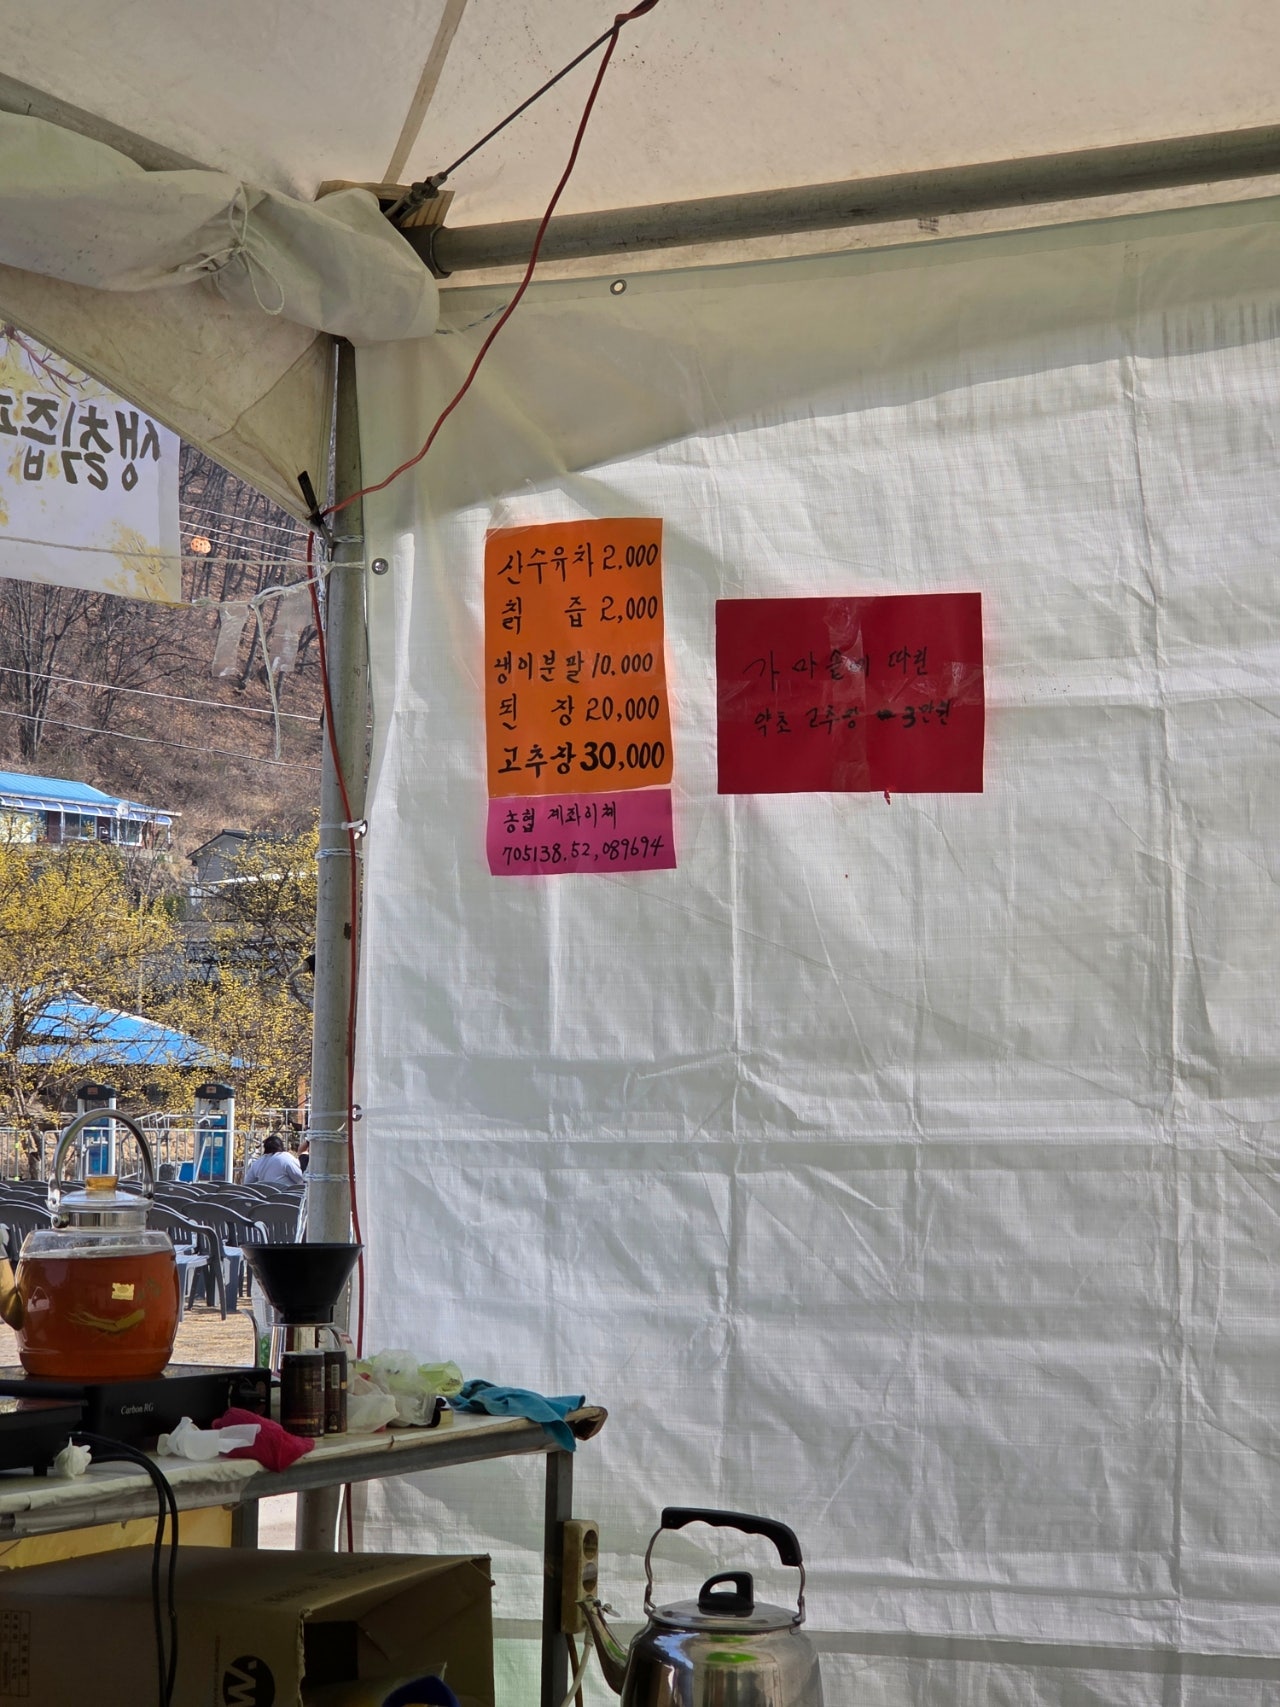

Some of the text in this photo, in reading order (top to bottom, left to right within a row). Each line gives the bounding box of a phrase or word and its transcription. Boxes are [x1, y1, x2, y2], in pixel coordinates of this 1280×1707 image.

[497, 542, 594, 585] 산수유차
[600, 595, 658, 624] 2,000
[585, 694, 660, 723] 20,000
[754, 708, 792, 737] 약초
[497, 741, 665, 779] 고추장 30,000
[503, 807, 536, 834] 농협
[120, 1405, 143, 1416] Carbon
